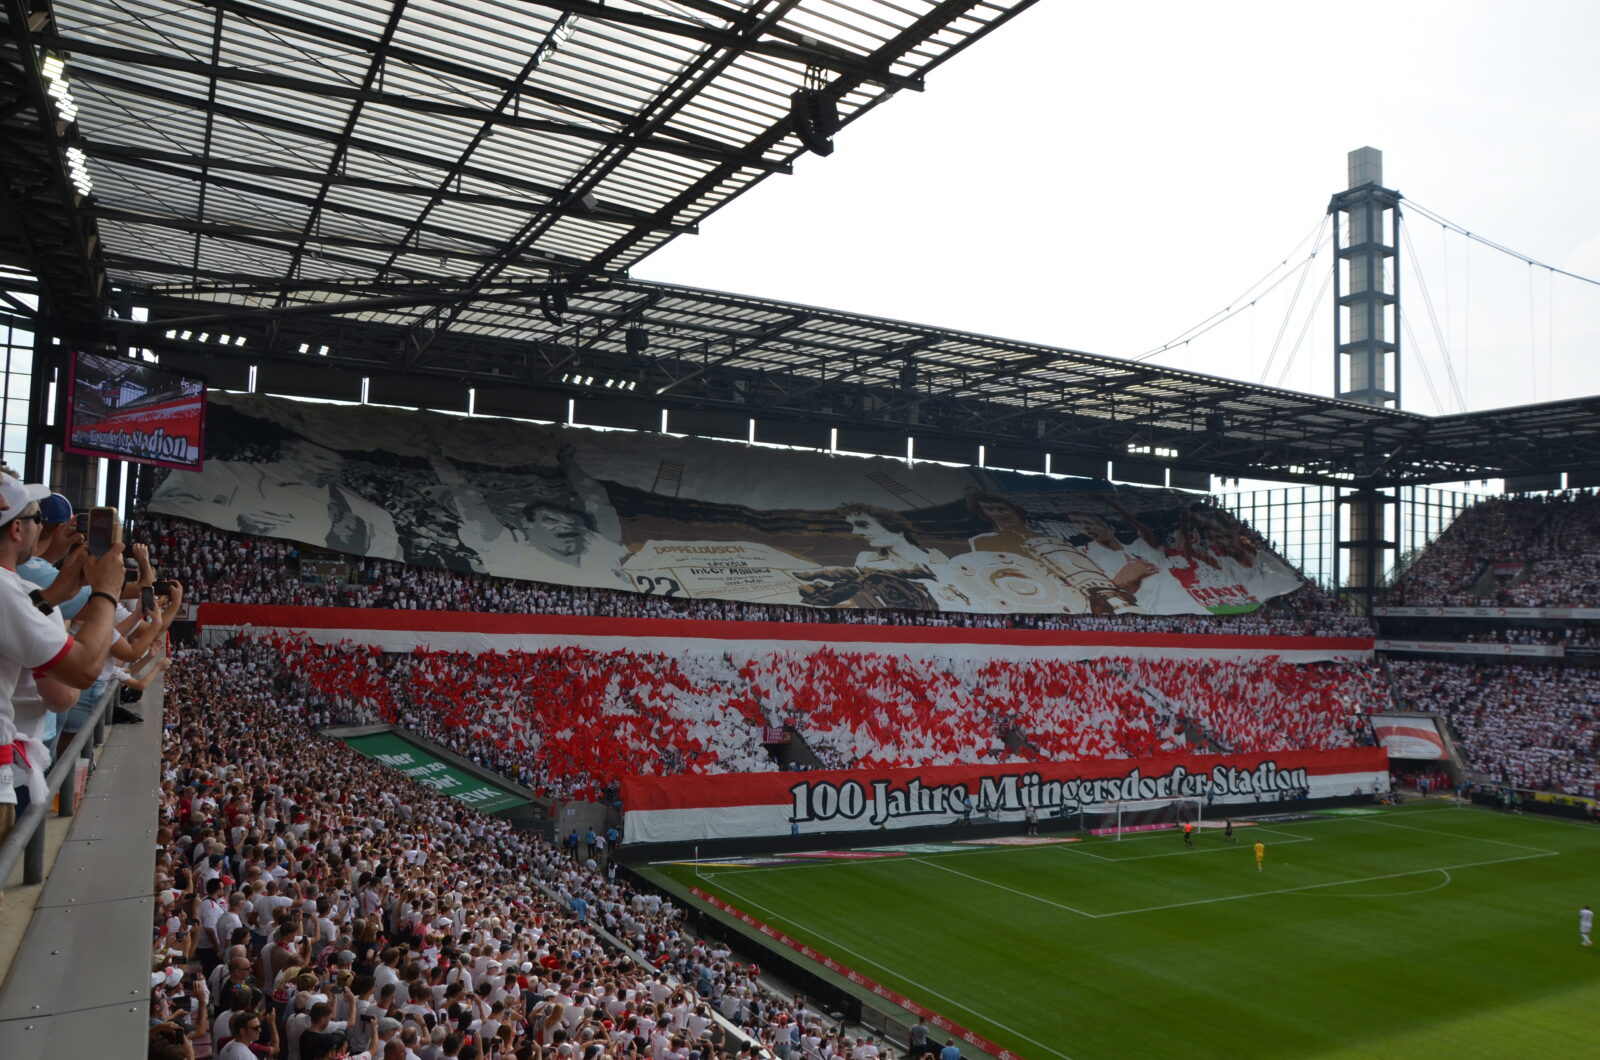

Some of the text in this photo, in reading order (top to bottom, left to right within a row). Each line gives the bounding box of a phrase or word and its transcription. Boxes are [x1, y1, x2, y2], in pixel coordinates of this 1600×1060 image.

[690, 567, 725, 575] Inter
[636, 575, 681, 597] 22
[375, 753, 416, 766] Mer
[425, 762, 447, 772] zo
[788, 759, 1309, 825] 100 Jahre Müngersdorfer Stadion
